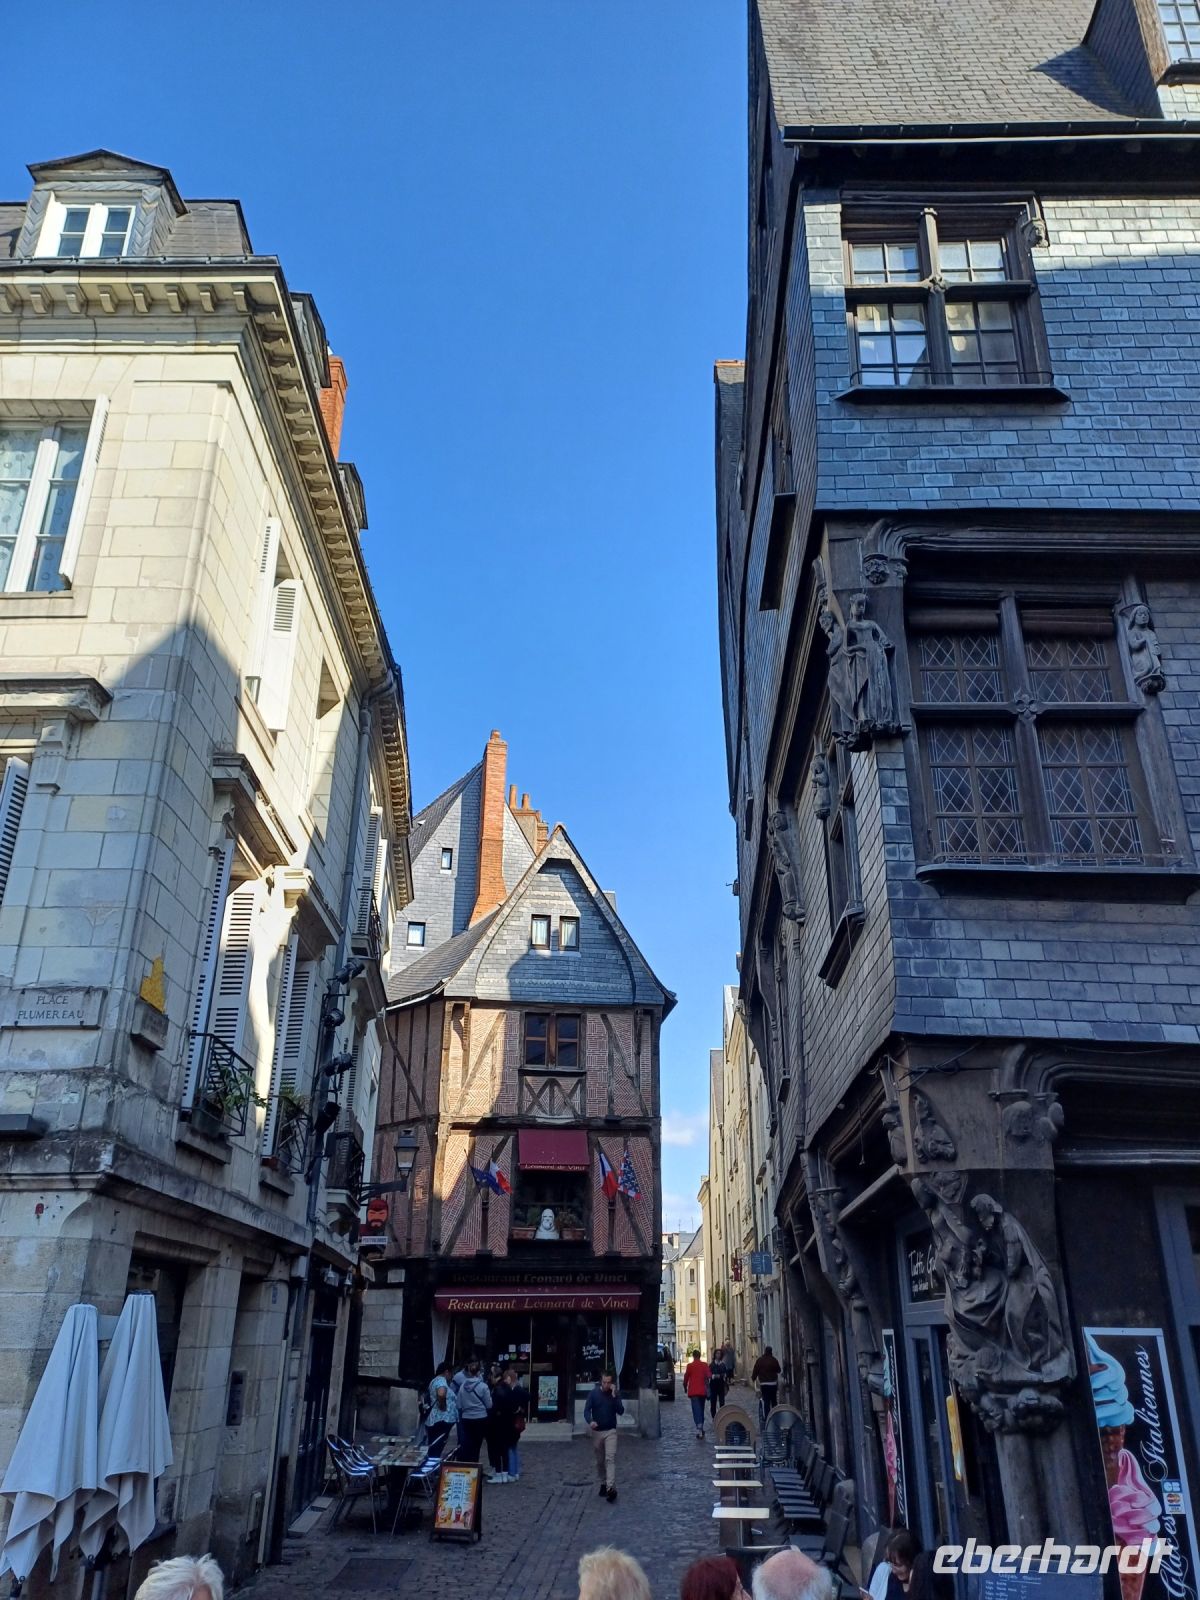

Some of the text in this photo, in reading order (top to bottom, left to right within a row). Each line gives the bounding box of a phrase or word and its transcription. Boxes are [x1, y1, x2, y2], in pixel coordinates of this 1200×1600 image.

[36, 995, 69, 1005] PLACE
[17, 1010, 84, 1020] PLUMEREAU
[448, 1298, 515, 1310] Restaurant
[581, 1297, 594, 1308] de
[600, 1296, 629, 1308] Vinci
[1134, 1344, 1168, 1482] Italiennes
